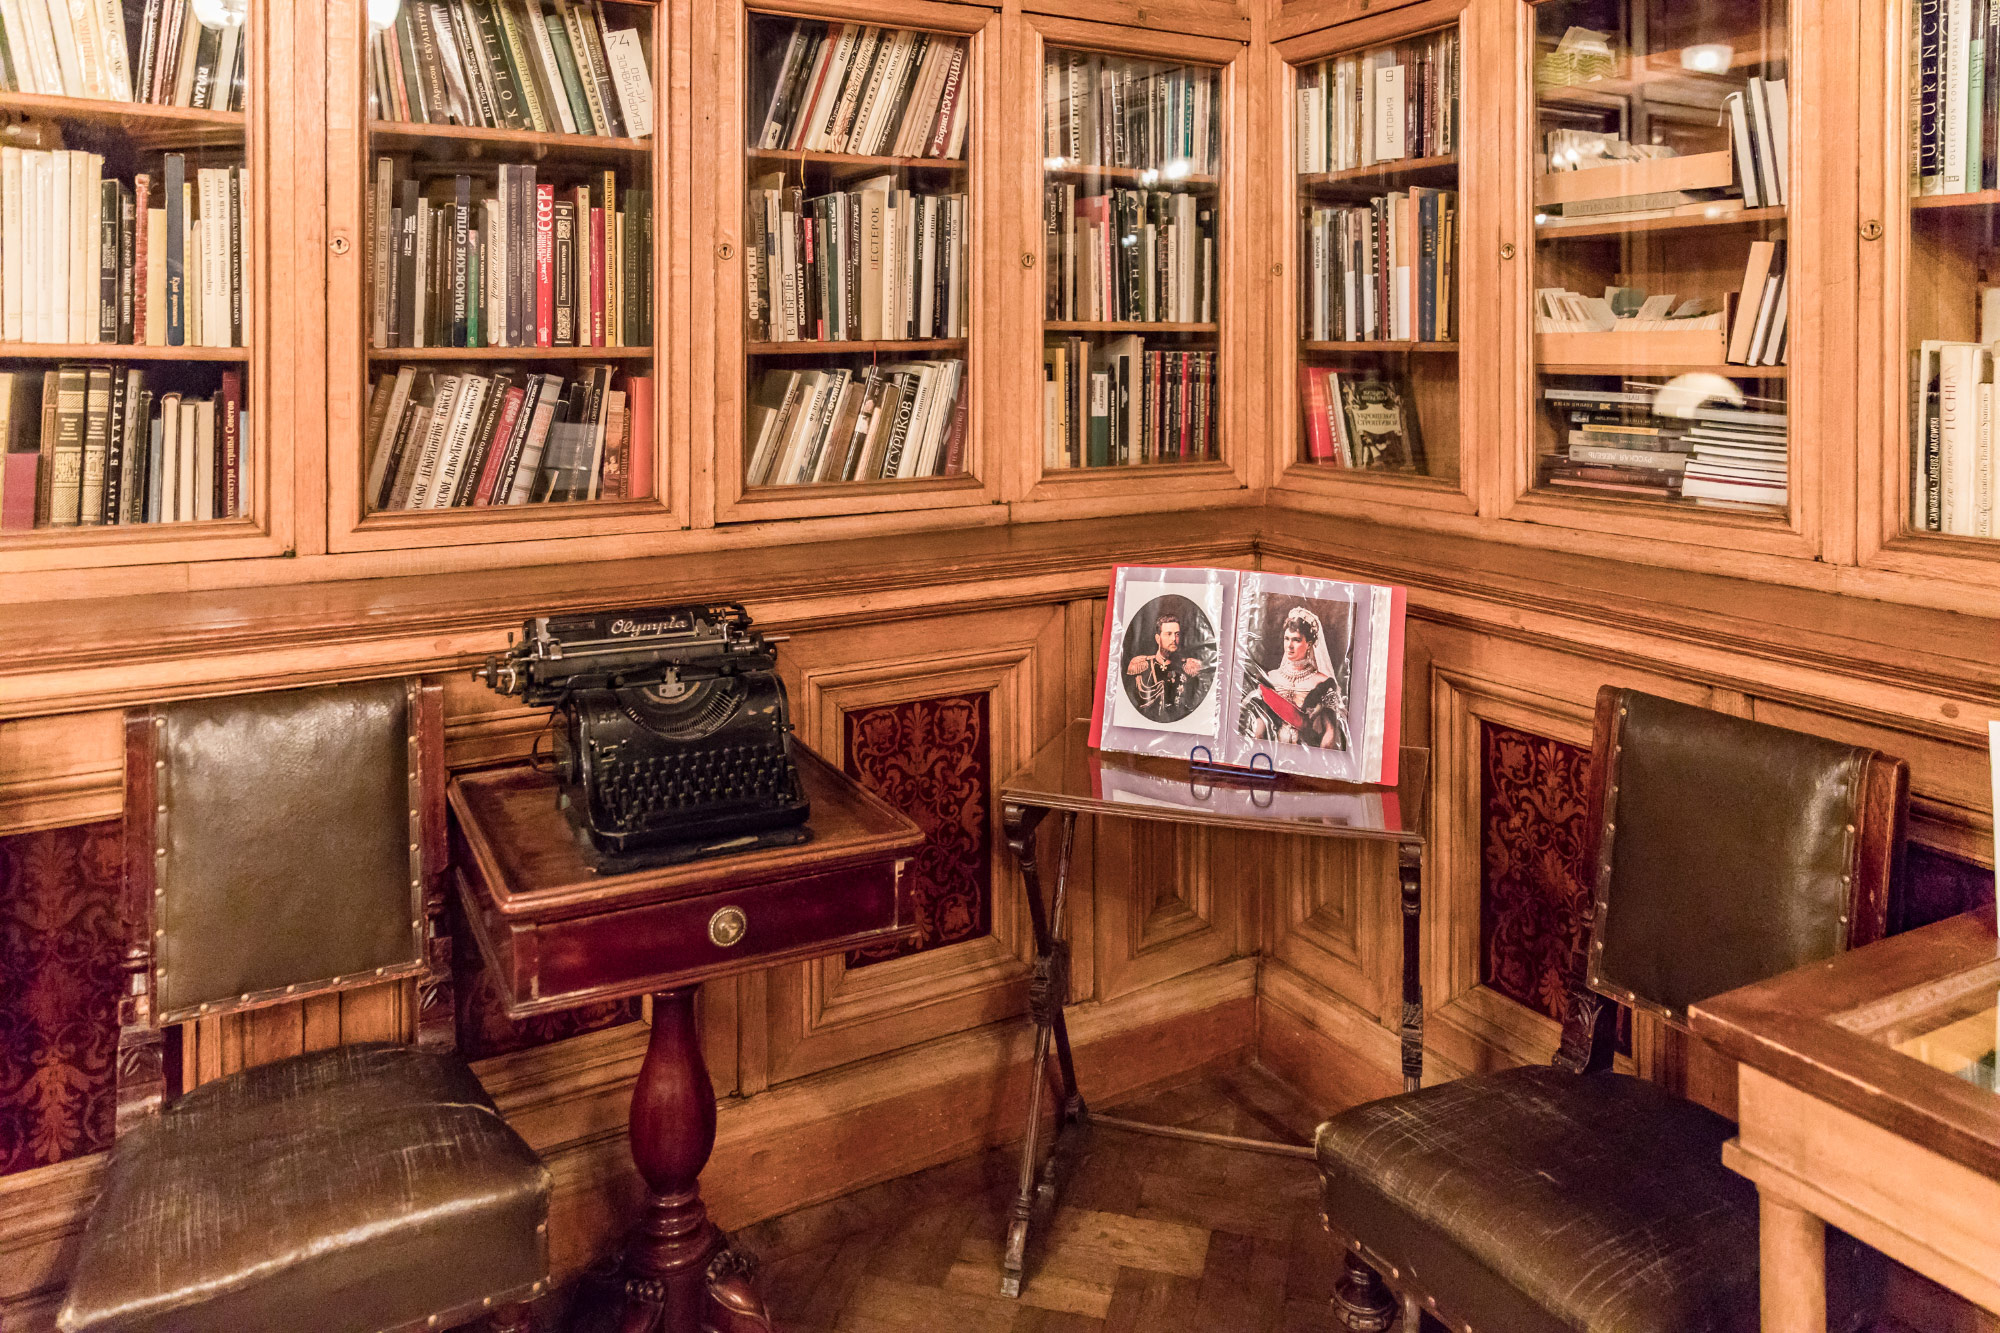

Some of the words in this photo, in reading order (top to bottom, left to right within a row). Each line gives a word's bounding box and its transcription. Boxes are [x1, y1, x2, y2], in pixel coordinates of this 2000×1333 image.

[417, 1, 434, 61] СКУЛЬПТУРА
[838, 32, 852, 62] ИВАНОВ
[887, 44, 903, 80] КРАМСКОЙ
[940, 47, 963, 115] КУСТОДИЕВ
[1950, 21, 1960, 102] CONTEMPORAINE
[193, 66, 209, 108] RYAZAN
[582, 62, 605, 130] СОВЕТСКАЯ
[616, 54, 645, 131] ДЕКОРАТИВНОЕ
[631, 66, 647, 104] ИС-ВО
[851, 86, 876, 150] КОНСТАНТИН
[872, 37, 892, 83] КОРОВИН
[934, 114, 949, 145] Борис
[1386, 96, 1394, 144] ИСТОРИЯ
[1948, 108, 1957, 166] COLLECTION
[455, 205, 468, 244] СИТЦЫ
[1047, 200, 1057, 235] Пуссен
[870, 207, 880, 271] НЕСТЕРОВ
[1371, 211, 1379, 277] ВАРШАВА
[454, 246, 466, 320] ИВАНОВСКИЕ
[746, 246, 759, 320] ОСМЕРКИН
[784, 272, 796, 324] ЛЕБЕДЕВ
[491, 398, 501, 409] XIX
[495, 382, 506, 398] ВЕКА
[808, 389, 823, 422] ФЕДОТОВ
[822, 374, 844, 426] П.Т.ФОМИН
[1944, 362, 1957, 431] LUCHIAN
[110, 376, 124, 466] БУХАРЕСТ
[225, 400, 235, 434] Советов
[418, 421, 445, 478] ДЕКОРАТИВНОЕ
[435, 378, 457, 420] ИСКУССТВО
[444, 421, 469, 478] ДЕКОРАТИВНОЕ
[462, 378, 482, 420] ИСКУССТВО
[480, 409, 496, 441] ИНТЕРЬЕРА
[509, 438, 523, 462] Русский
[518, 407, 531, 438] народный
[527, 384, 538, 407] костюм
[1929, 417, 1940, 452] MAKOWSKI
[226, 435, 236, 466] страны
[472, 441, 486, 466] ЖИЛОГО
[884, 400, 913, 477] И.СУРИКОВ
[1588, 450, 1617, 461] МЕБЕЛЬ
[1980, 427, 1989, 462] Tradition
[1619, 454, 1653, 464] РУССКАЯ
[1929, 454, 1940, 482] TADEUSZ
[463, 466, 478, 498] РУССКОГО
[1929, 486, 1940, 521] JAWORSKA
[611, 614, 689, 637] Olympia
